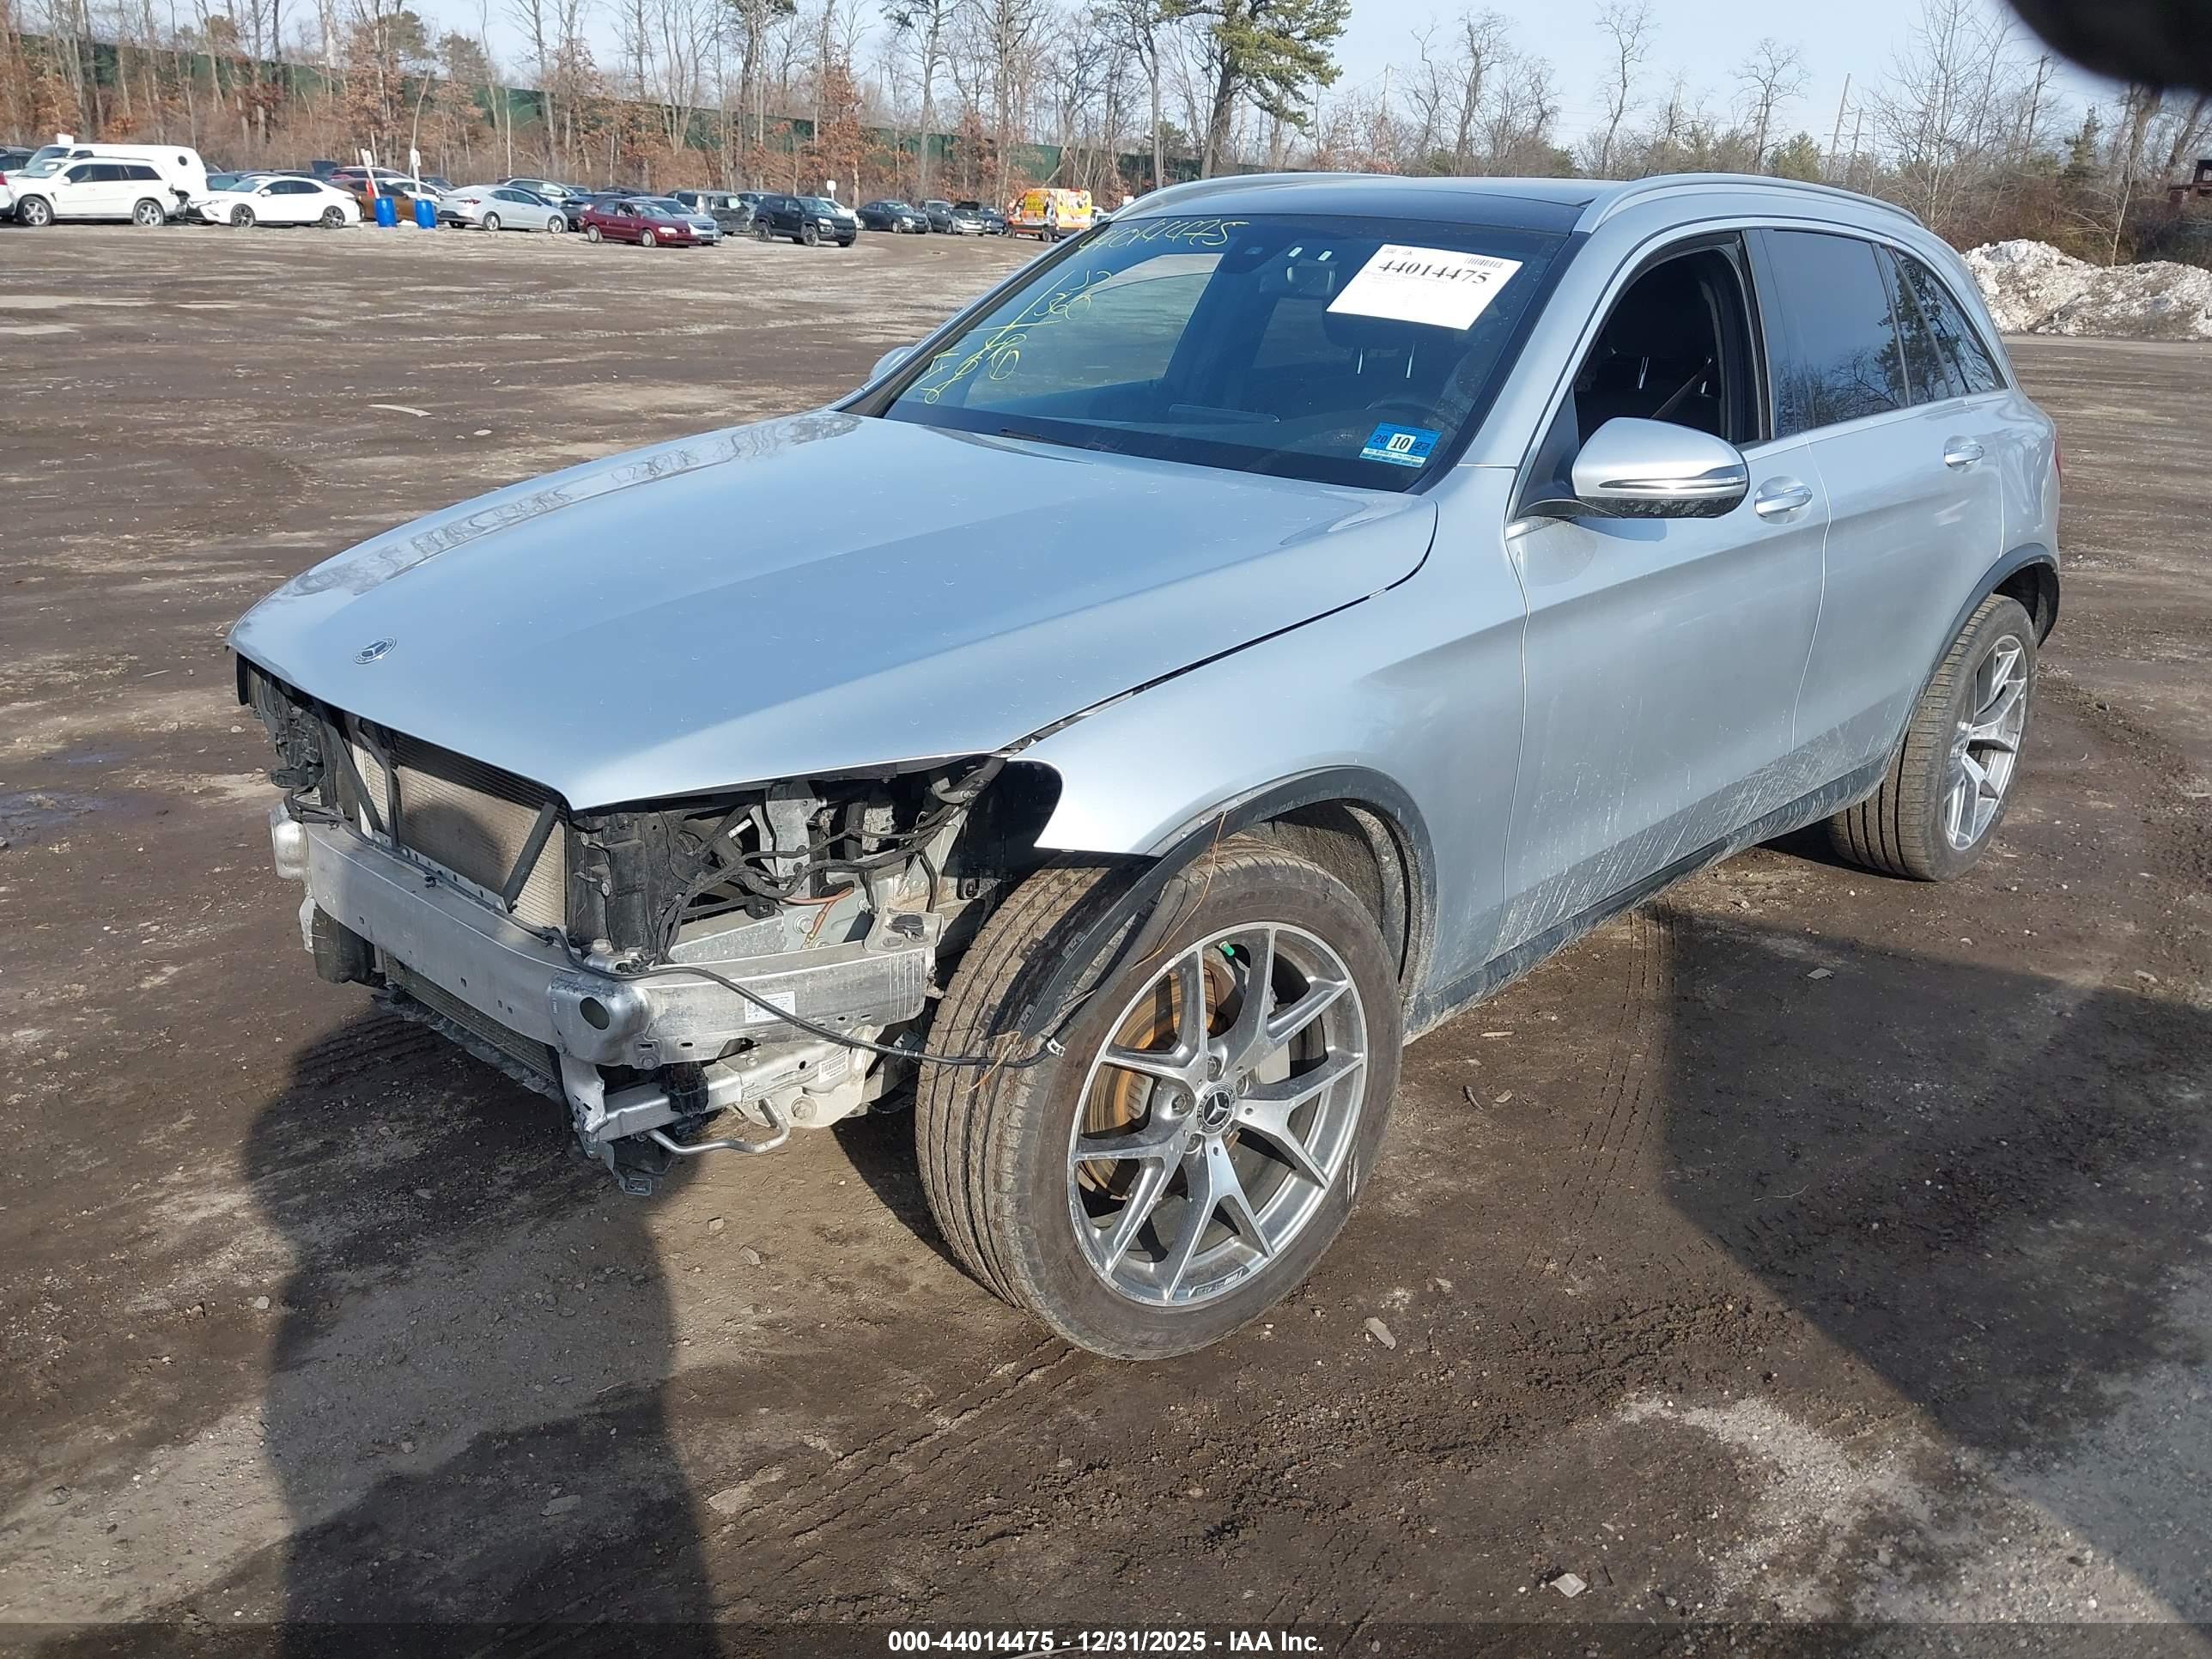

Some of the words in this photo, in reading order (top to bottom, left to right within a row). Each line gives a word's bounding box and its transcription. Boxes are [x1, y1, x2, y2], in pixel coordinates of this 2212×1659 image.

[1378, 259, 1492, 284] 44014475
[1374, 434, 1389, 444] 20
[1390, 435, 1411, 450] 10
